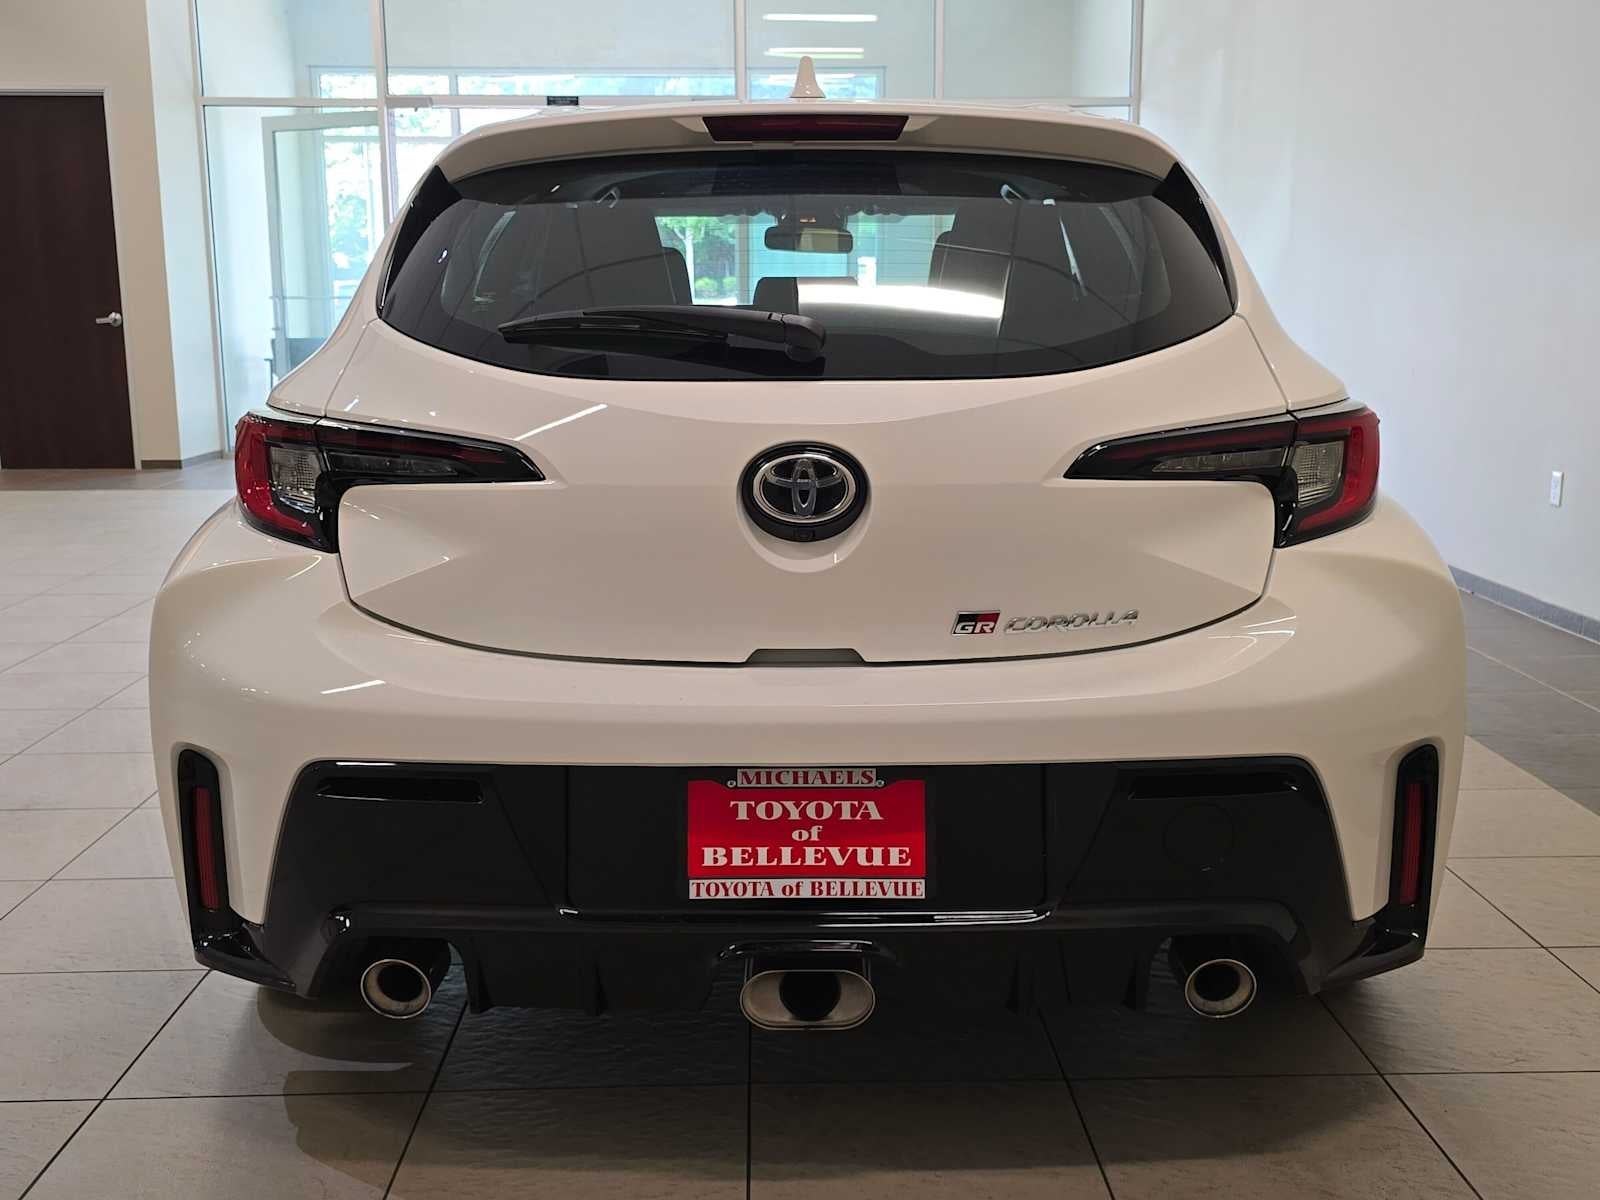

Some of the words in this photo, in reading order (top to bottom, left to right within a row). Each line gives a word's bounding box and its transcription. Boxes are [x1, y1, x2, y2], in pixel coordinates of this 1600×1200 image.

[1003, 608, 1139, 632] COROLLA
[740, 770, 875, 785] MICHAELS
[730, 800, 884, 820] TOYOTA
[791, 825, 823, 841] of
[701, 846, 912, 867] BELLEVUE
[692, 882, 774, 897] TOYOTA
[781, 882, 804, 897] of
[810, 881, 924, 897] BELLEVUE
